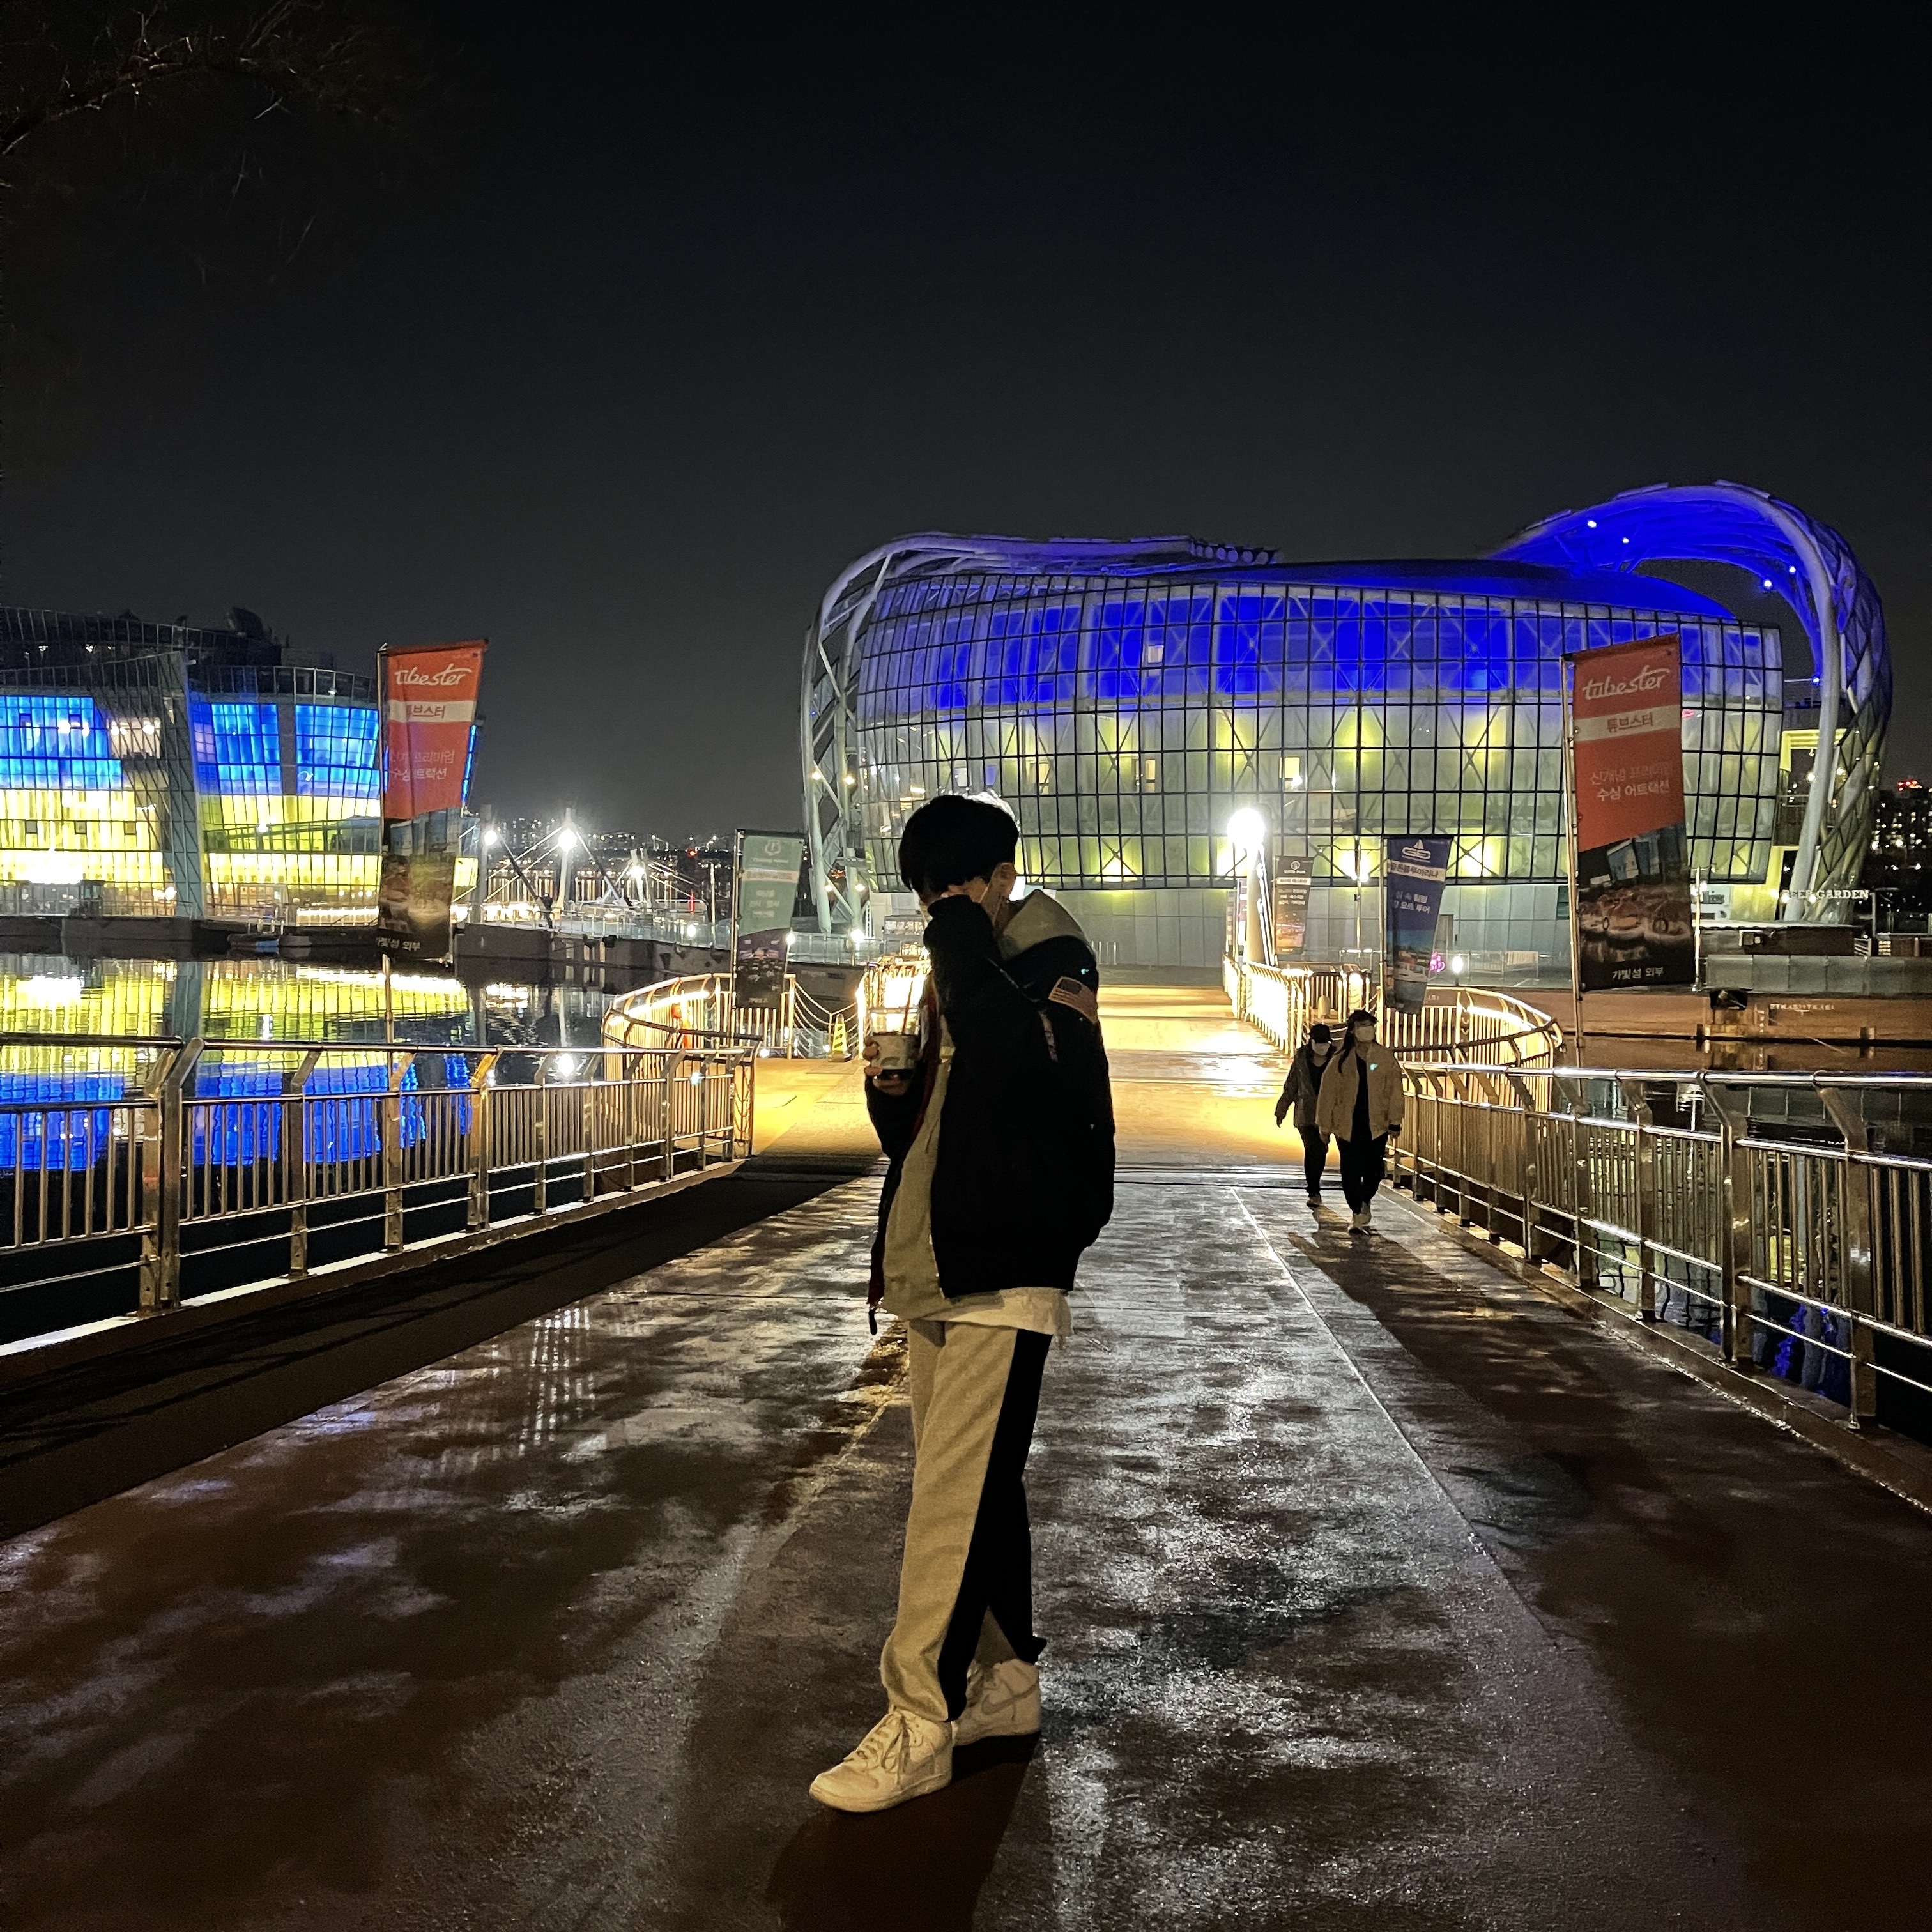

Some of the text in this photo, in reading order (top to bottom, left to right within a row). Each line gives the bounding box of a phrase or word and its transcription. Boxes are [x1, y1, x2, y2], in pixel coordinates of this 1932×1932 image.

[1582, 664, 1671, 700] tubester
[1606, 712, 1653, 733] 튜브스터
[1816, 889, 1870, 900] GARDEN
